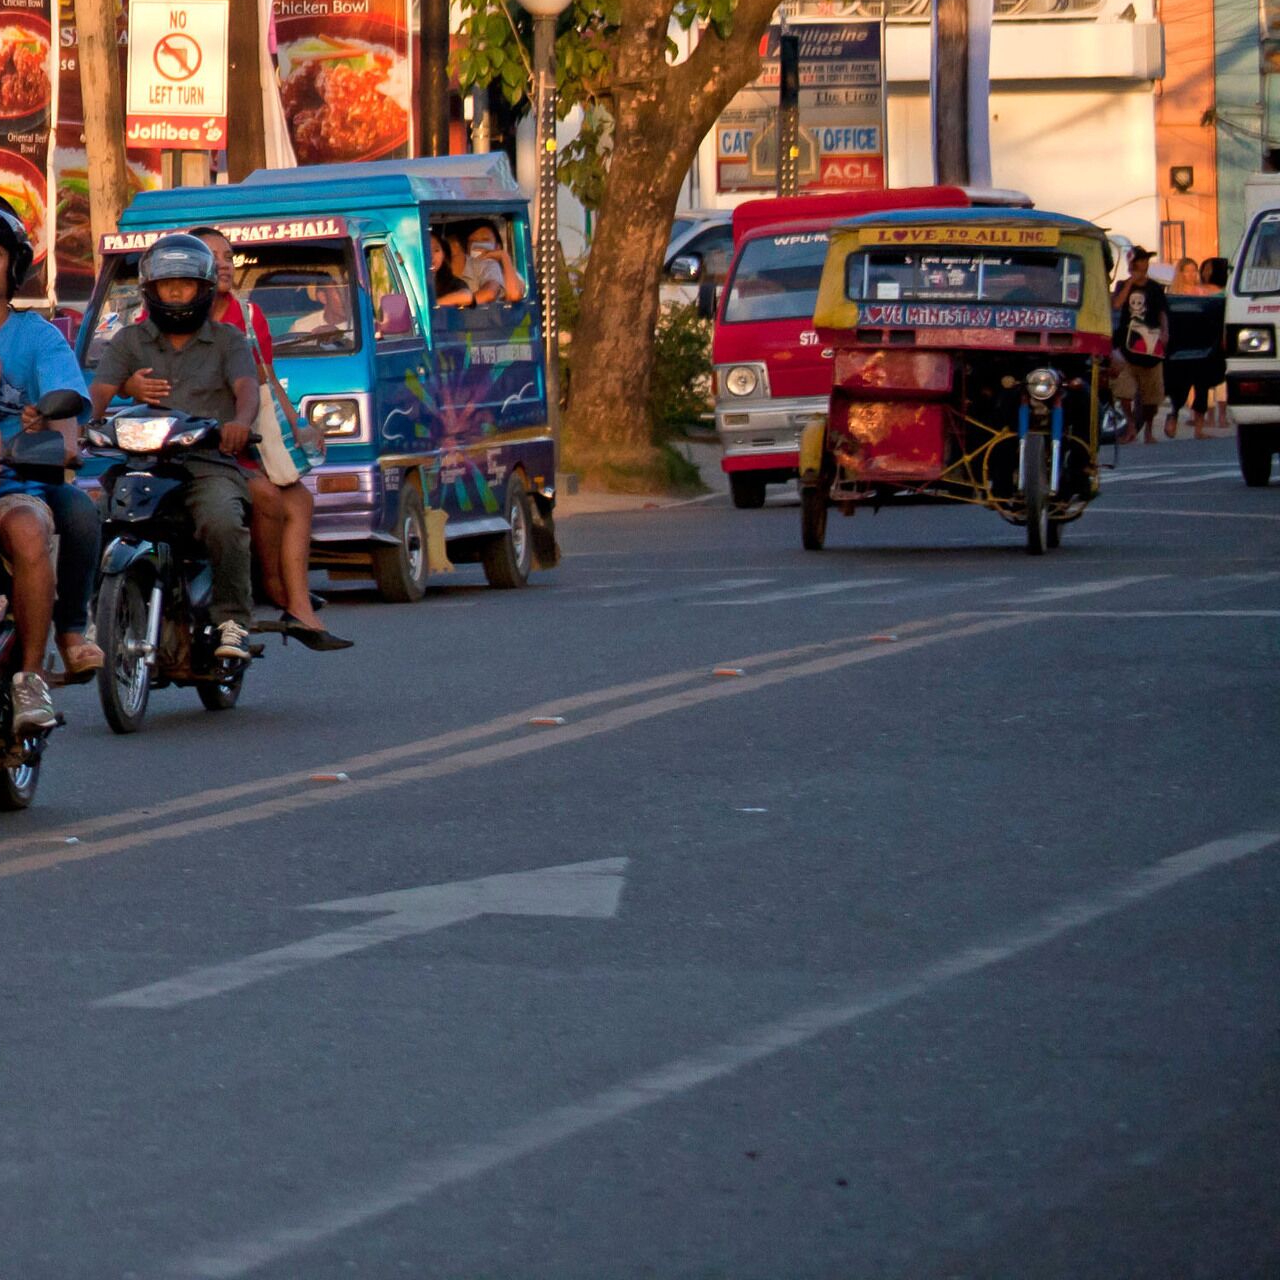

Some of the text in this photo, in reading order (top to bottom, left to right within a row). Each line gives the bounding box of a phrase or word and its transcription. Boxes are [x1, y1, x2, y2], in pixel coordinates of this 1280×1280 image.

[272, 0, 370, 16] Chicken Bowl
[169, 10, 187, 30] NO
[149, 85, 204, 106] LEFT TURN
[7, 131, 34, 143] Oriental
[127, 120, 200, 141] Jollibee
[823, 127, 877, 151] OFFICE
[20, 143, 36, 154] Bowl
[975, 229, 1012, 243] ALL
